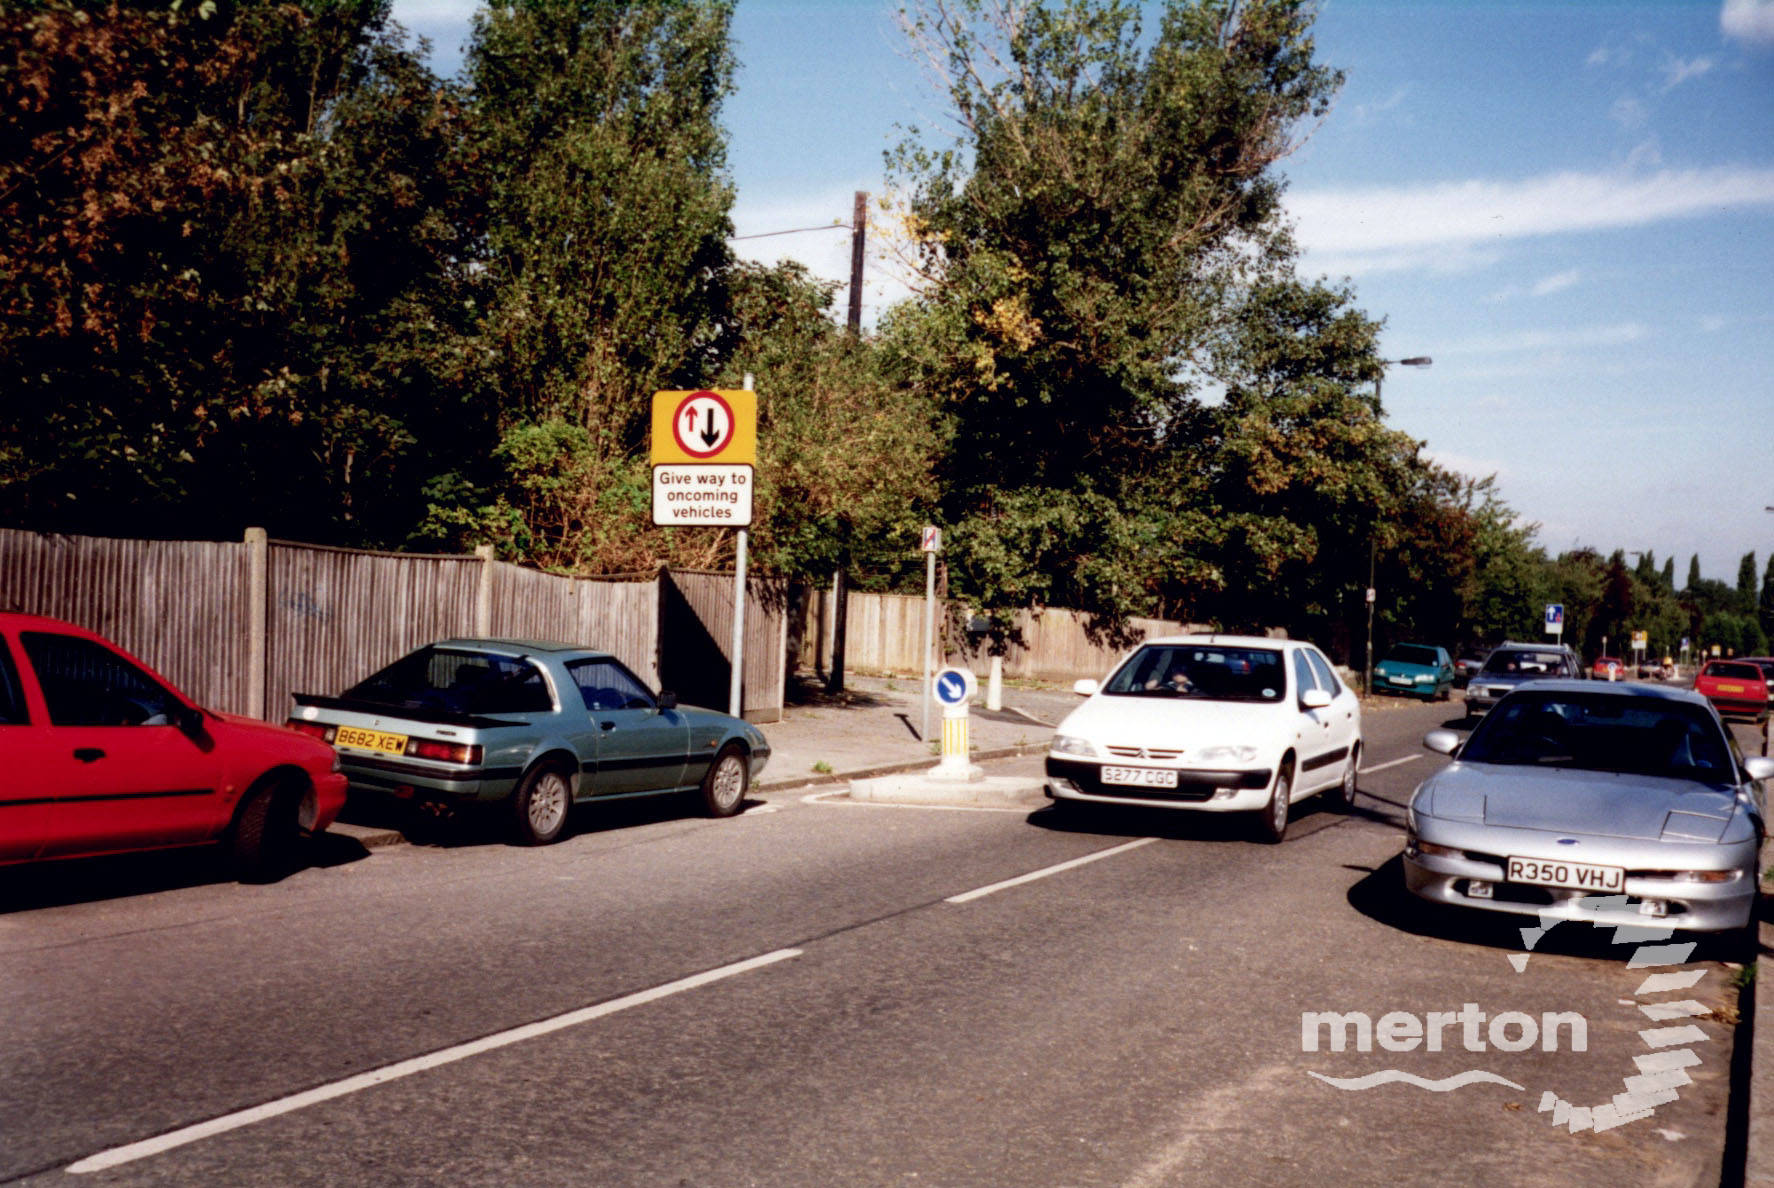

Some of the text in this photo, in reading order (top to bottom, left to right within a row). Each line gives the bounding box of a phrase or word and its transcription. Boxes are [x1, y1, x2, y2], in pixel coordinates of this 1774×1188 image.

[660, 472, 746, 487] Give way to
[667, 489, 738, 503] oncoming
[673, 506, 732, 518] vehicles
[338, 729, 405, 752] B682 XEW
[1104, 768, 1142, 782] S277
[1510, 861, 1620, 889] R350 VHJ
